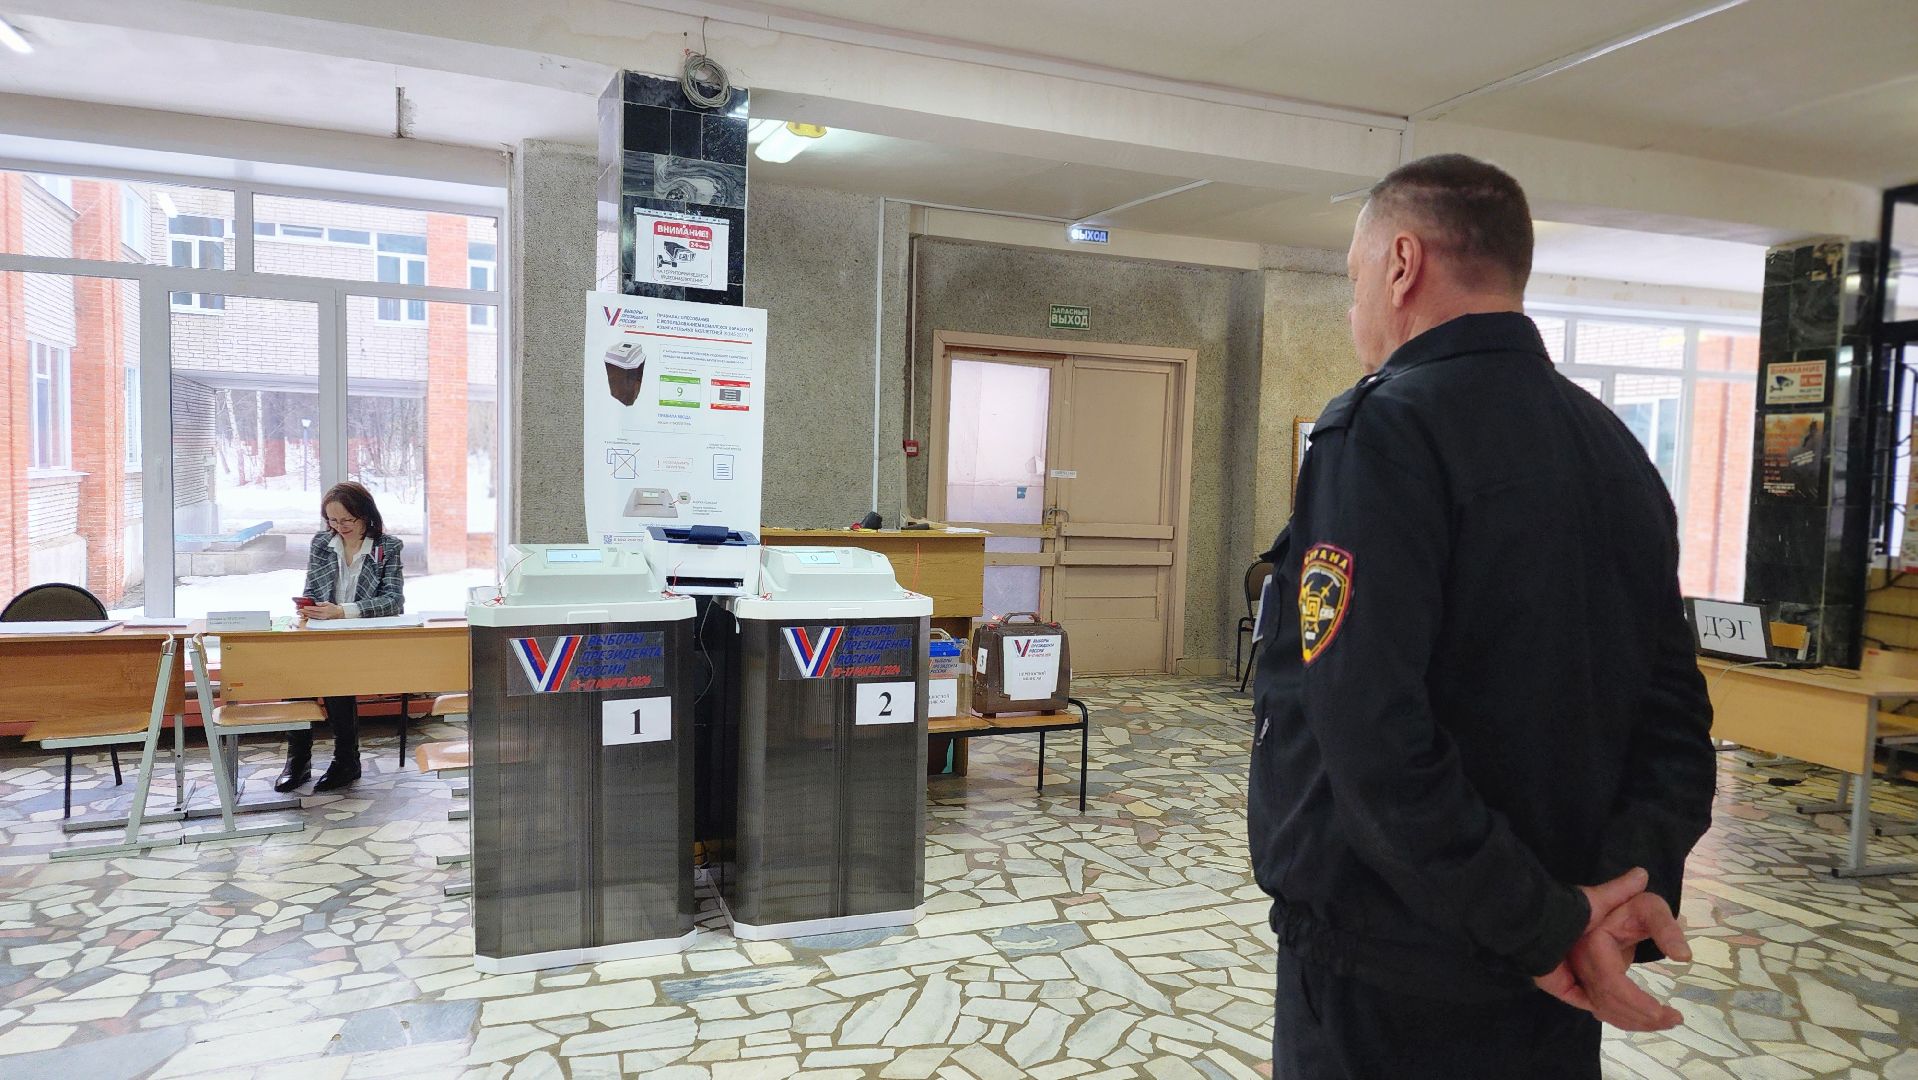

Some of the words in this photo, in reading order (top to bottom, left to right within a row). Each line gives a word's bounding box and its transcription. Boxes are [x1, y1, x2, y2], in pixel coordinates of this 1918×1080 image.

[657, 224, 709, 238] ВНИМАНИЕ!
[1070, 228, 1107, 242] ВЫХОД
[1052, 307, 1089, 316] ЗАПАСНЫЙ
[1051, 314, 1089, 328] ВЫХОД
[676, 387, 683, 397] 9
[848, 626, 897, 637] ВЫБОРЫ
[1704, 615, 1751, 641] ДЭГ
[588, 633, 644, 647] ВЫБОРЫ
[843, 636, 912, 651] ПРЕЗИДЕНТА
[581, 646, 662, 662] ПРЕЗИДЕНТА
[835, 653, 881, 668] РОССИИ
[575, 664, 627, 677] РОССИИ
[878, 691, 893, 717] 2
[630, 708, 643, 735] 1
